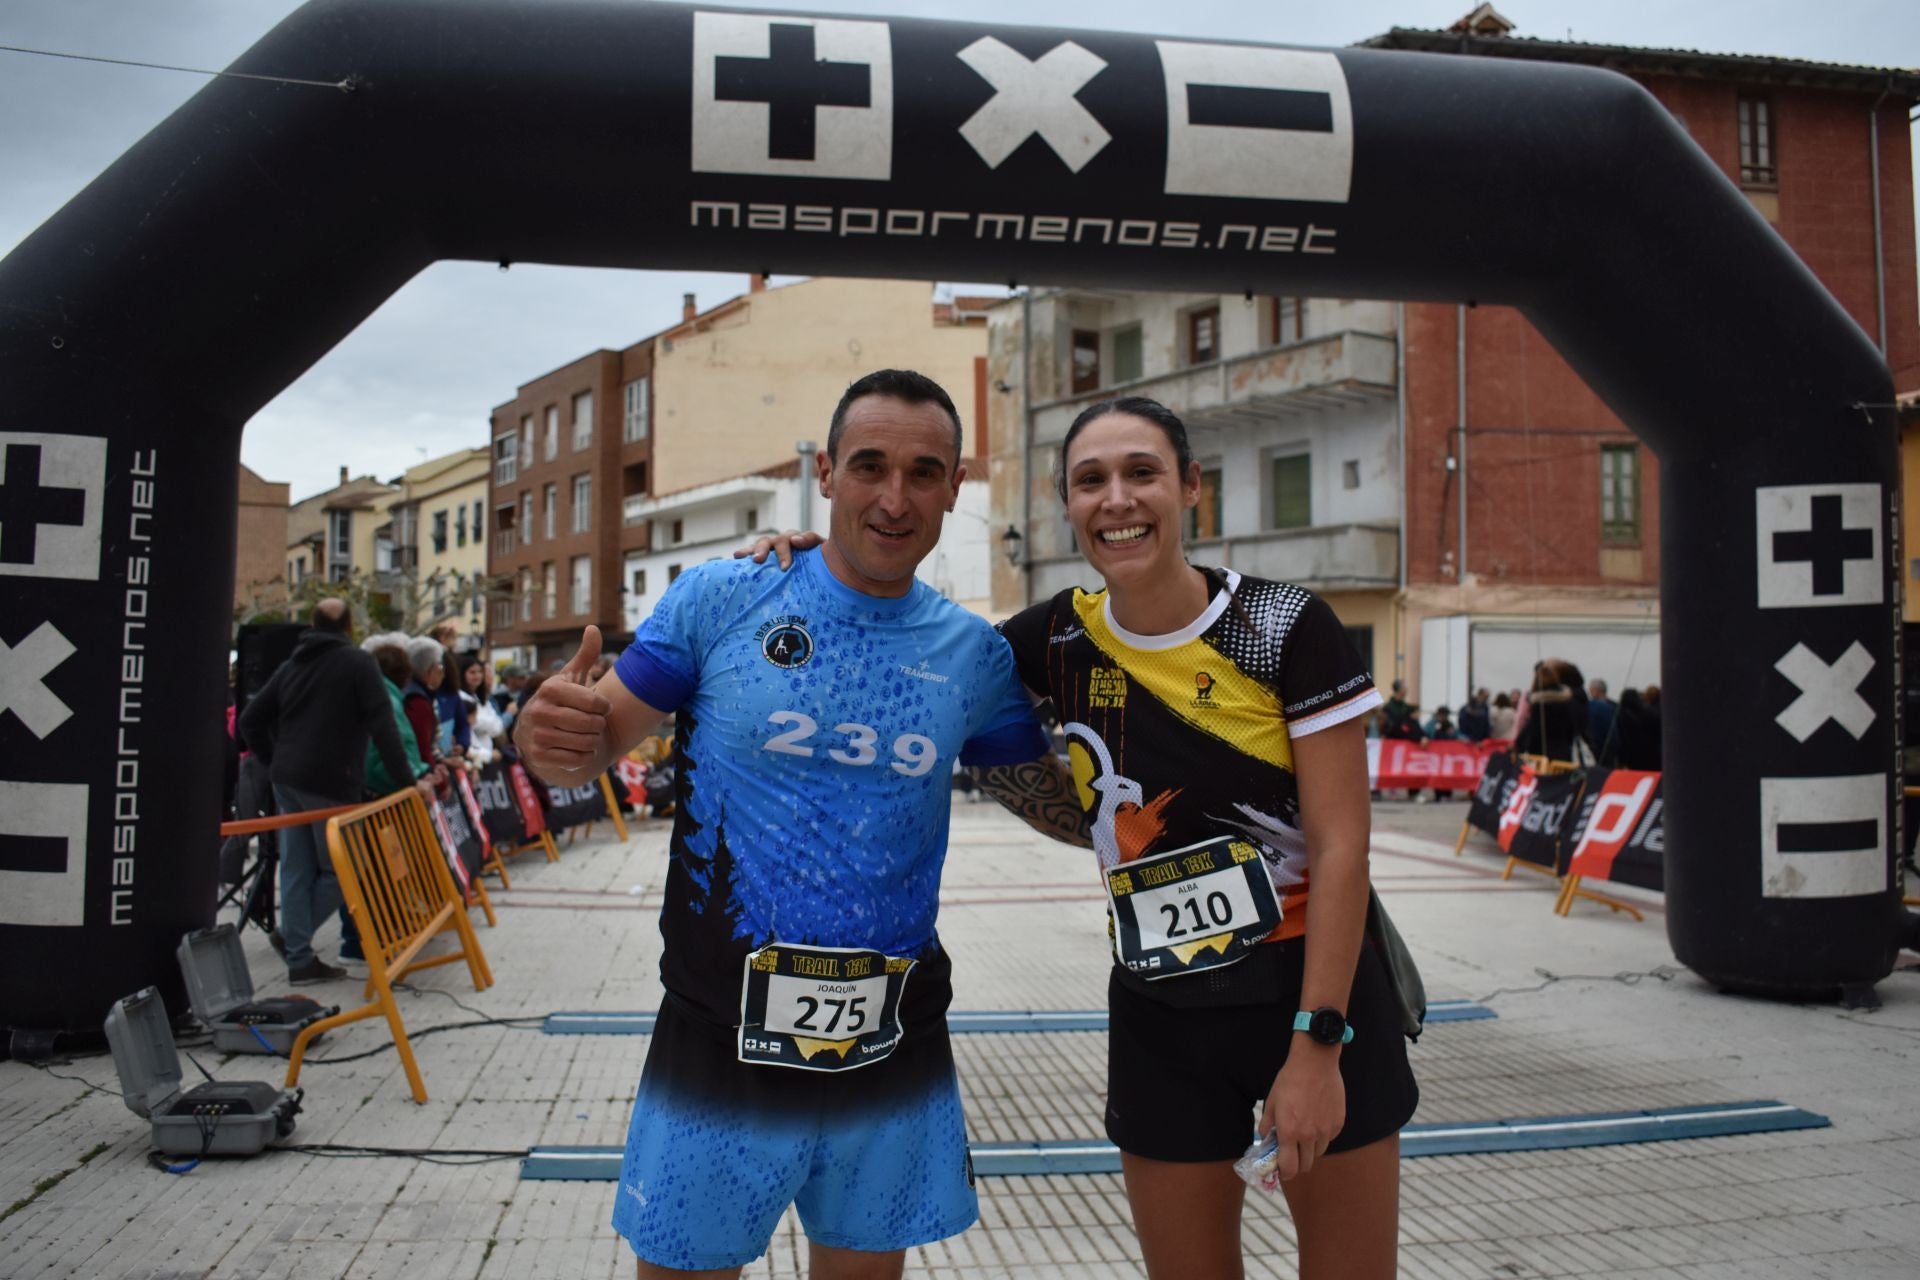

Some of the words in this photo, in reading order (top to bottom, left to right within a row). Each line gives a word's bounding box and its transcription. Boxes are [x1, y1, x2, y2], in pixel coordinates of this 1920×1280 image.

[690, 200, 1337, 256] maspormenos.net
[110, 448, 157, 926] maspormenos.net
[899, 665, 950, 684] TEAMERGY
[1285, 689, 1334, 714] SEGURIDAD
[763, 710, 938, 777] 239
[1139, 862, 1181, 886] TRAIL
[1178, 883, 1199, 895] ALBA
[1159, 890, 1233, 940] 210
[793, 955, 839, 977] TRAIL
[817, 983, 857, 994] JOAQUÍN
[793, 996, 868, 1033] 275
